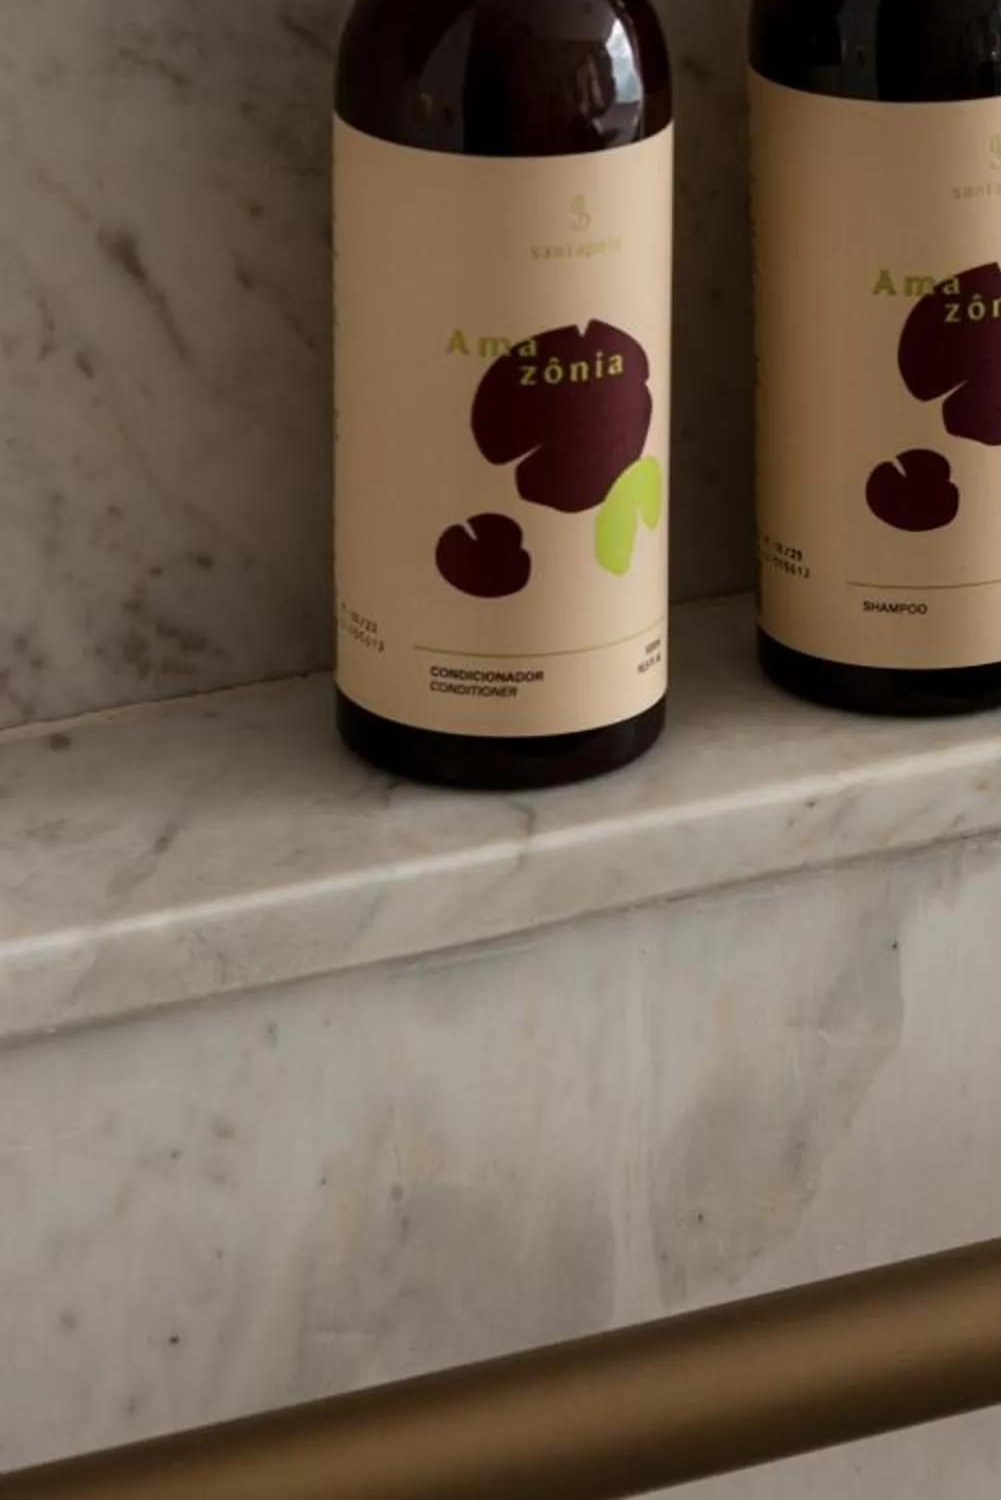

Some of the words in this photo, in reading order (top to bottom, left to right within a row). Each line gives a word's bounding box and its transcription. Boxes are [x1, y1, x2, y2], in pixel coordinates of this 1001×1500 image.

[871, 269, 961, 297] Ama
[448, 328, 538, 358] Ama
[519, 351, 624, 386] zônia
[863, 600, 928, 615] SHAMPOO
[430, 665, 544, 683] CONDICIONADOR
[430, 680, 518, 698] CONDITIONER
